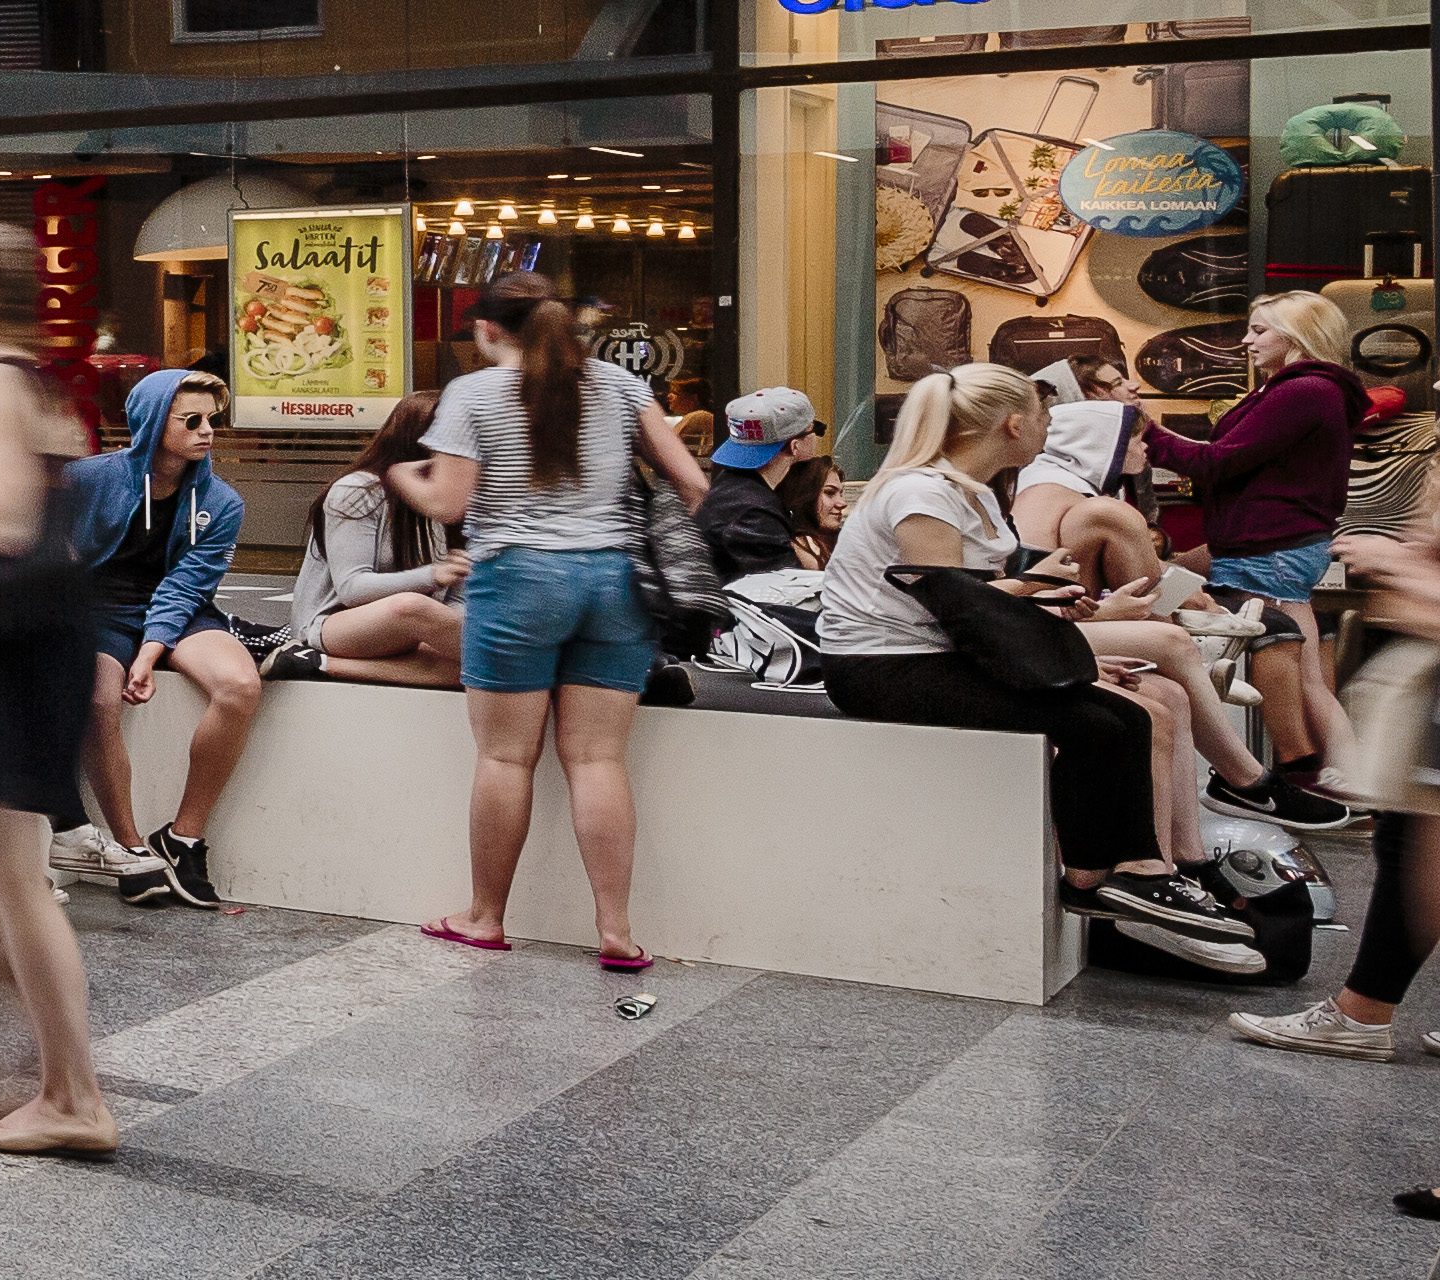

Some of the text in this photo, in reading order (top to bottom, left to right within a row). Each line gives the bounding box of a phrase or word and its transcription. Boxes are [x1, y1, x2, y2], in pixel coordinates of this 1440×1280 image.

[1083, 148, 1195, 179] Lomaa
[1093, 166, 1223, 200] kaikesta
[1080, 199, 1218, 211] KAIKKEA LOMAAN
[254, 235, 385, 274] Salaatit
[281, 401, 355, 418] HESBURGER
